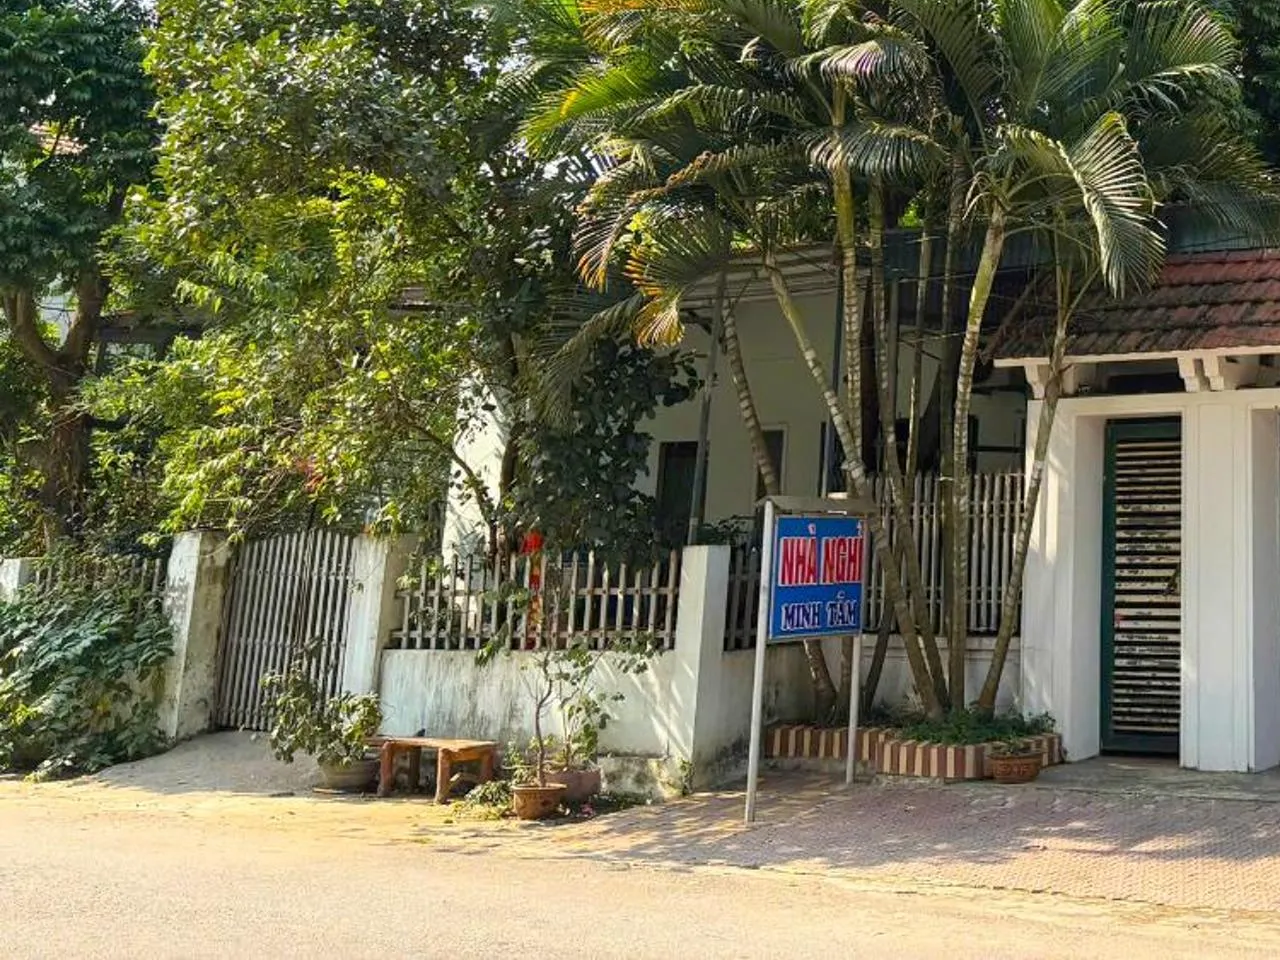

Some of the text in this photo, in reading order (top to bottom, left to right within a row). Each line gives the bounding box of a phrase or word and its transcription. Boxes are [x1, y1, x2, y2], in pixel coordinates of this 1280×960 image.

[778, 520, 863, 587] NHÀ NGHỈ
[781, 603, 822, 631] MINH
